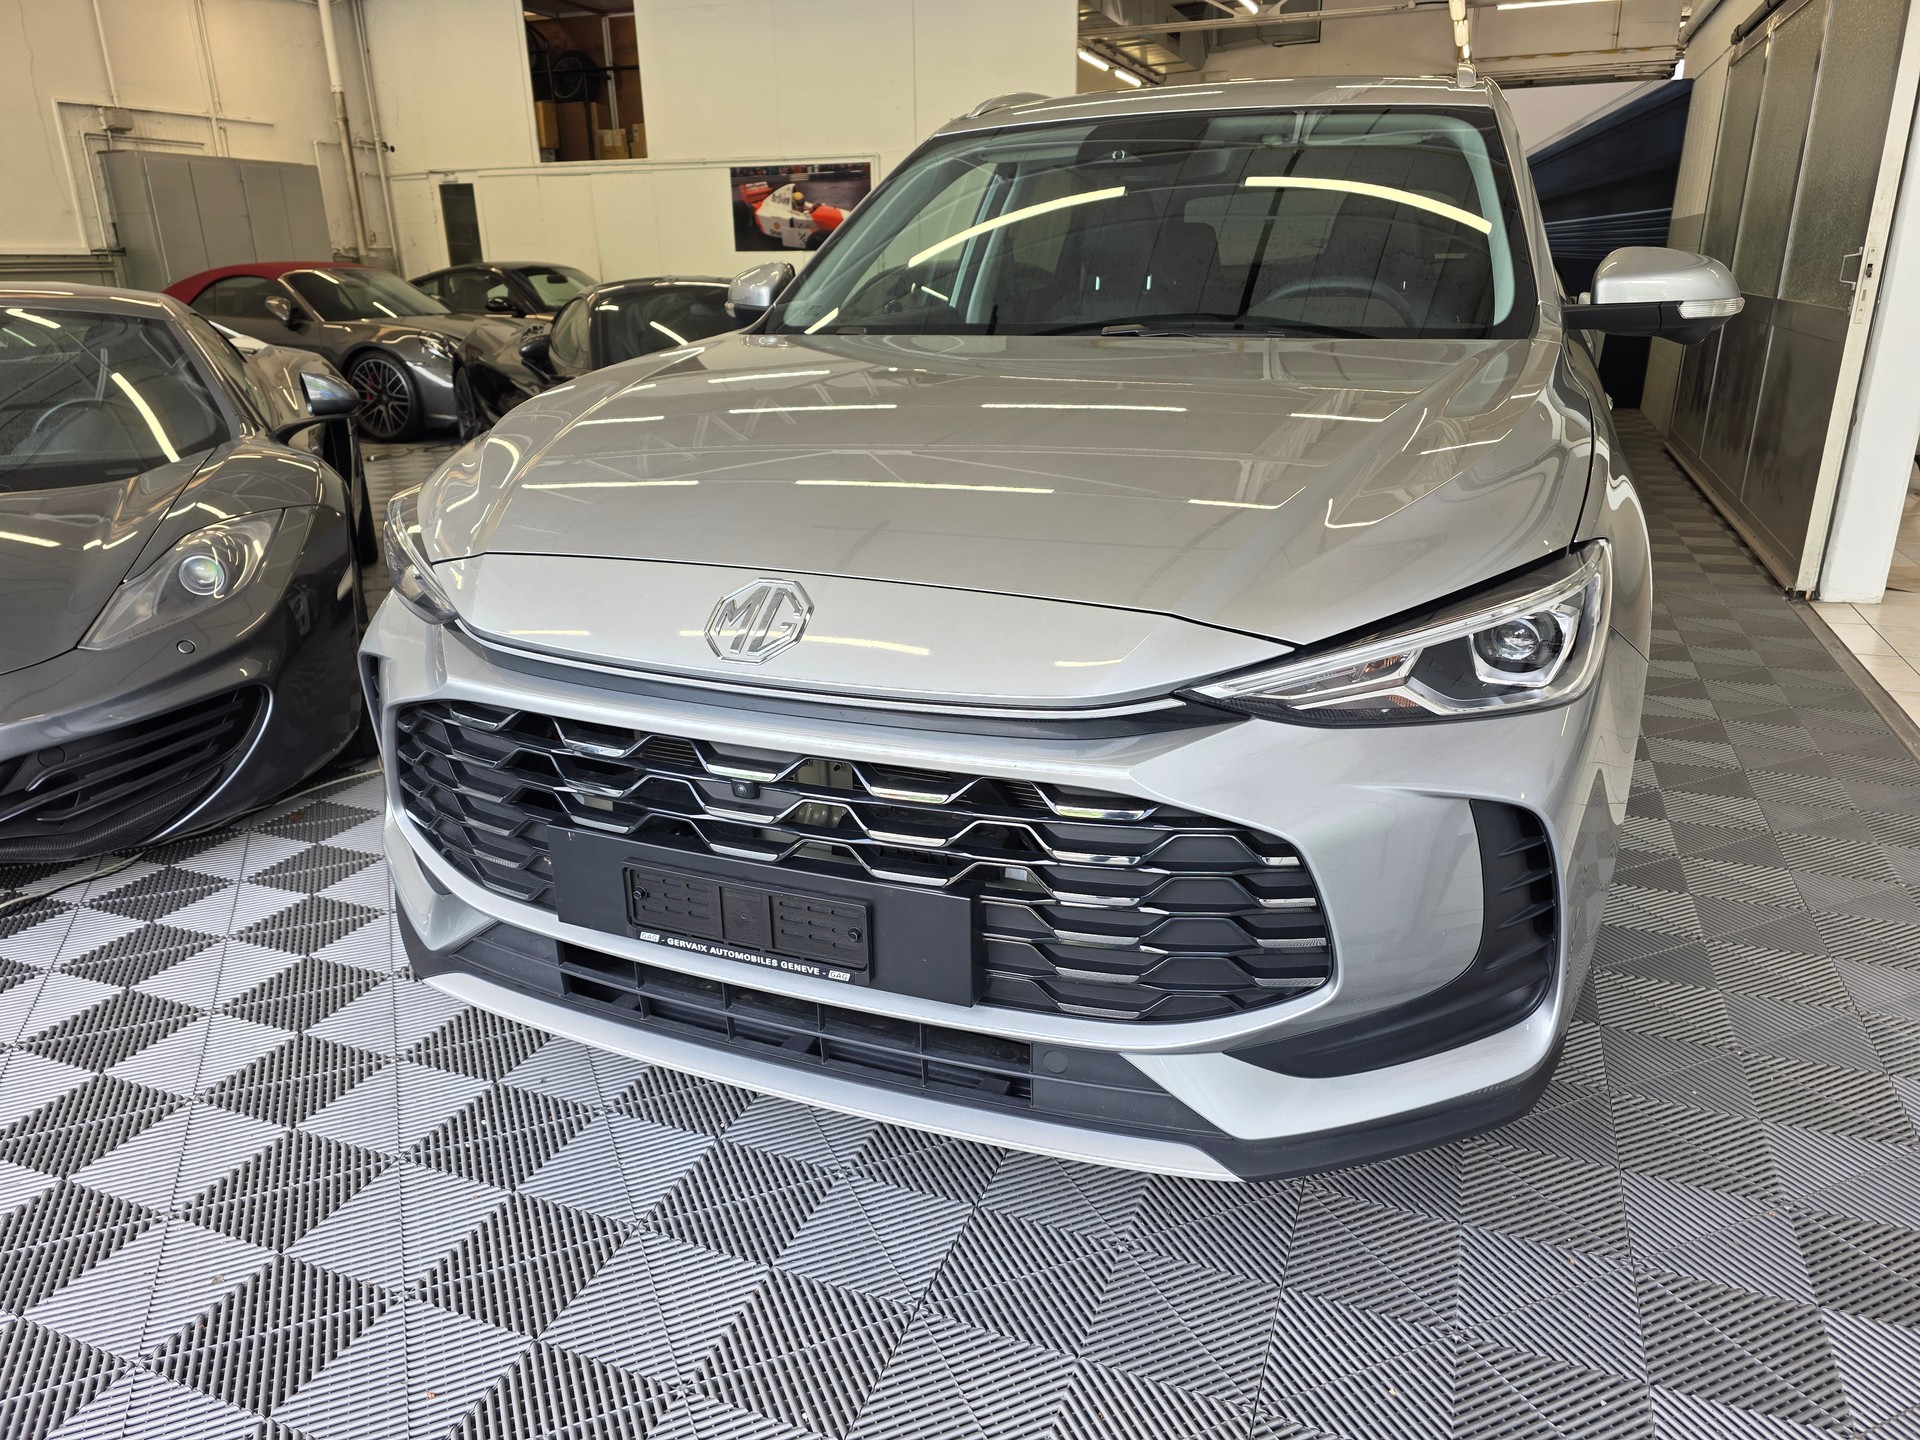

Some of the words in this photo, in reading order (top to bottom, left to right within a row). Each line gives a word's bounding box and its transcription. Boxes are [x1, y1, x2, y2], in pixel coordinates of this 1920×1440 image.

[713, 585, 804, 657] MG
[640, 932, 659, 942] GAG
[667, 938, 707, 952] GERVAIX
[710, 947, 778, 966] AUTOMOBILES
[781, 961, 820, 975] GENEVE
[830, 971, 849, 981] GAG
